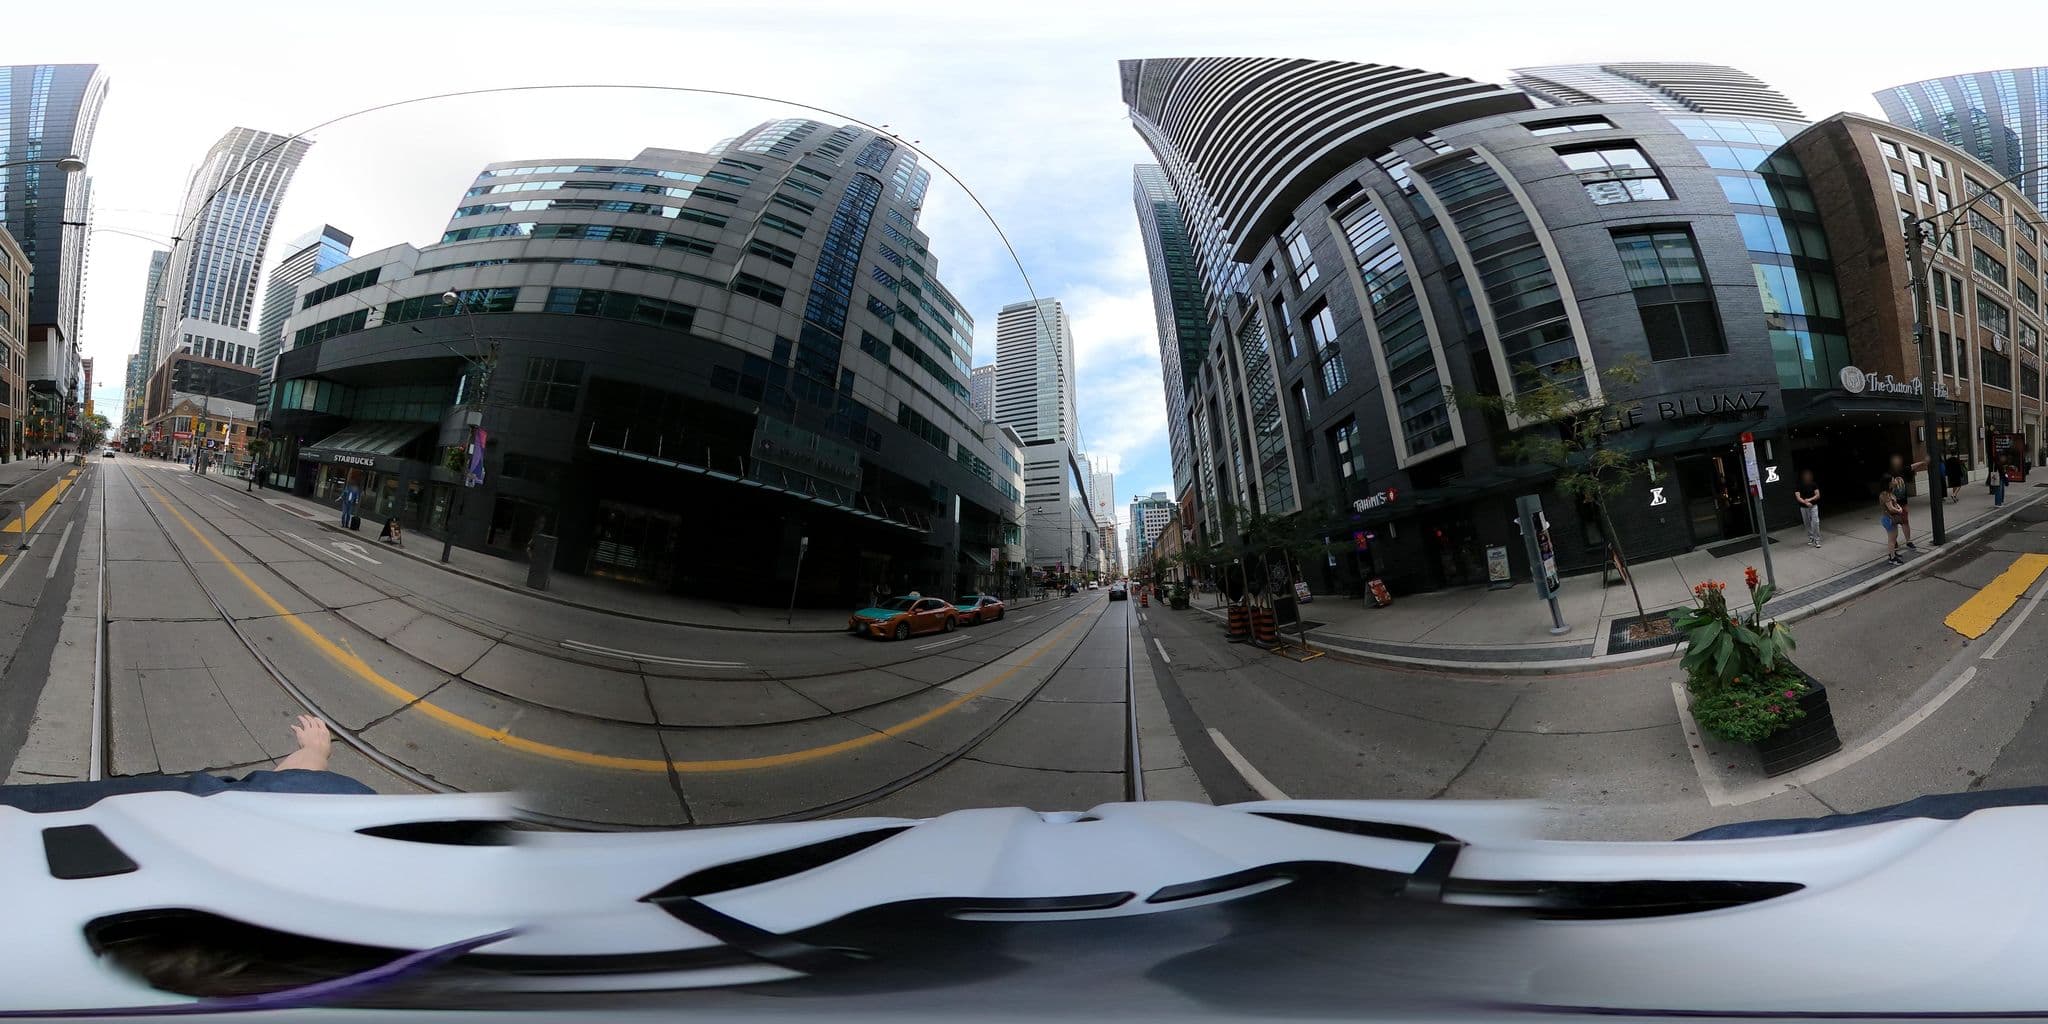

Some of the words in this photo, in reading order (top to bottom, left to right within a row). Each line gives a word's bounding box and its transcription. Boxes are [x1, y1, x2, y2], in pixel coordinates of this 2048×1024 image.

[1866, 371, 1884, 392] The
[1884, 374, 1912, 394] Sutton
[333, 453, 376, 467] STARBUCKS
